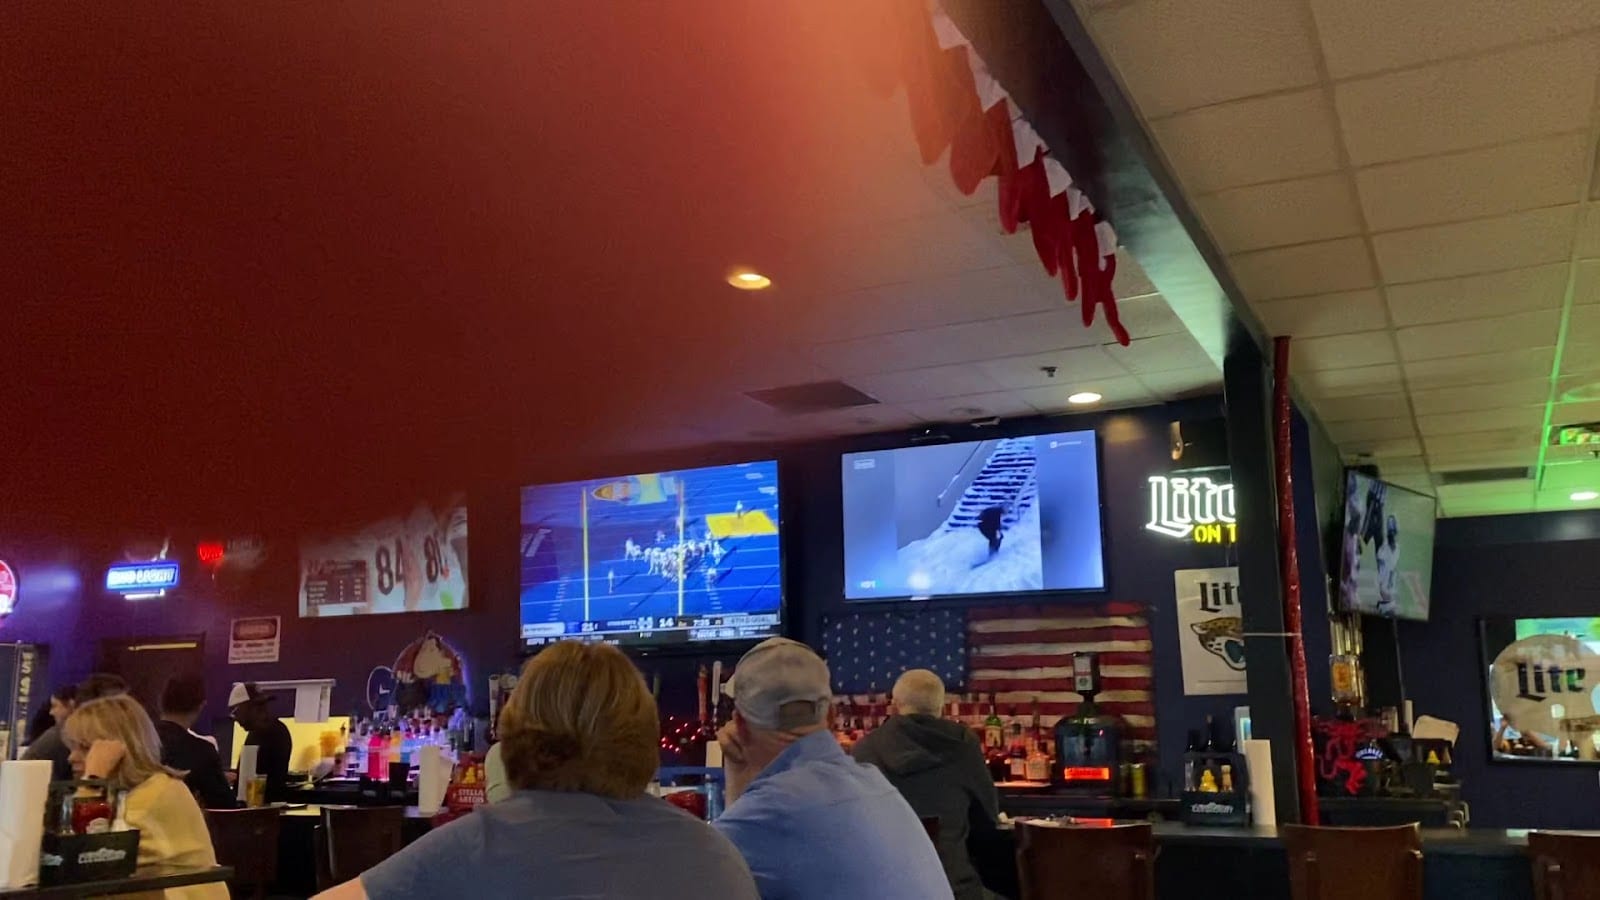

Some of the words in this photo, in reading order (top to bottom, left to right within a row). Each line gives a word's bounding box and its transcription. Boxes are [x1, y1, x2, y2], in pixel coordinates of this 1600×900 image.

[1194, 524, 1221, 543] ON
[1198, 582, 1241, 613] Lit
[1516, 660, 1585, 703] Lite
[459, 788, 484, 797] STELLA
